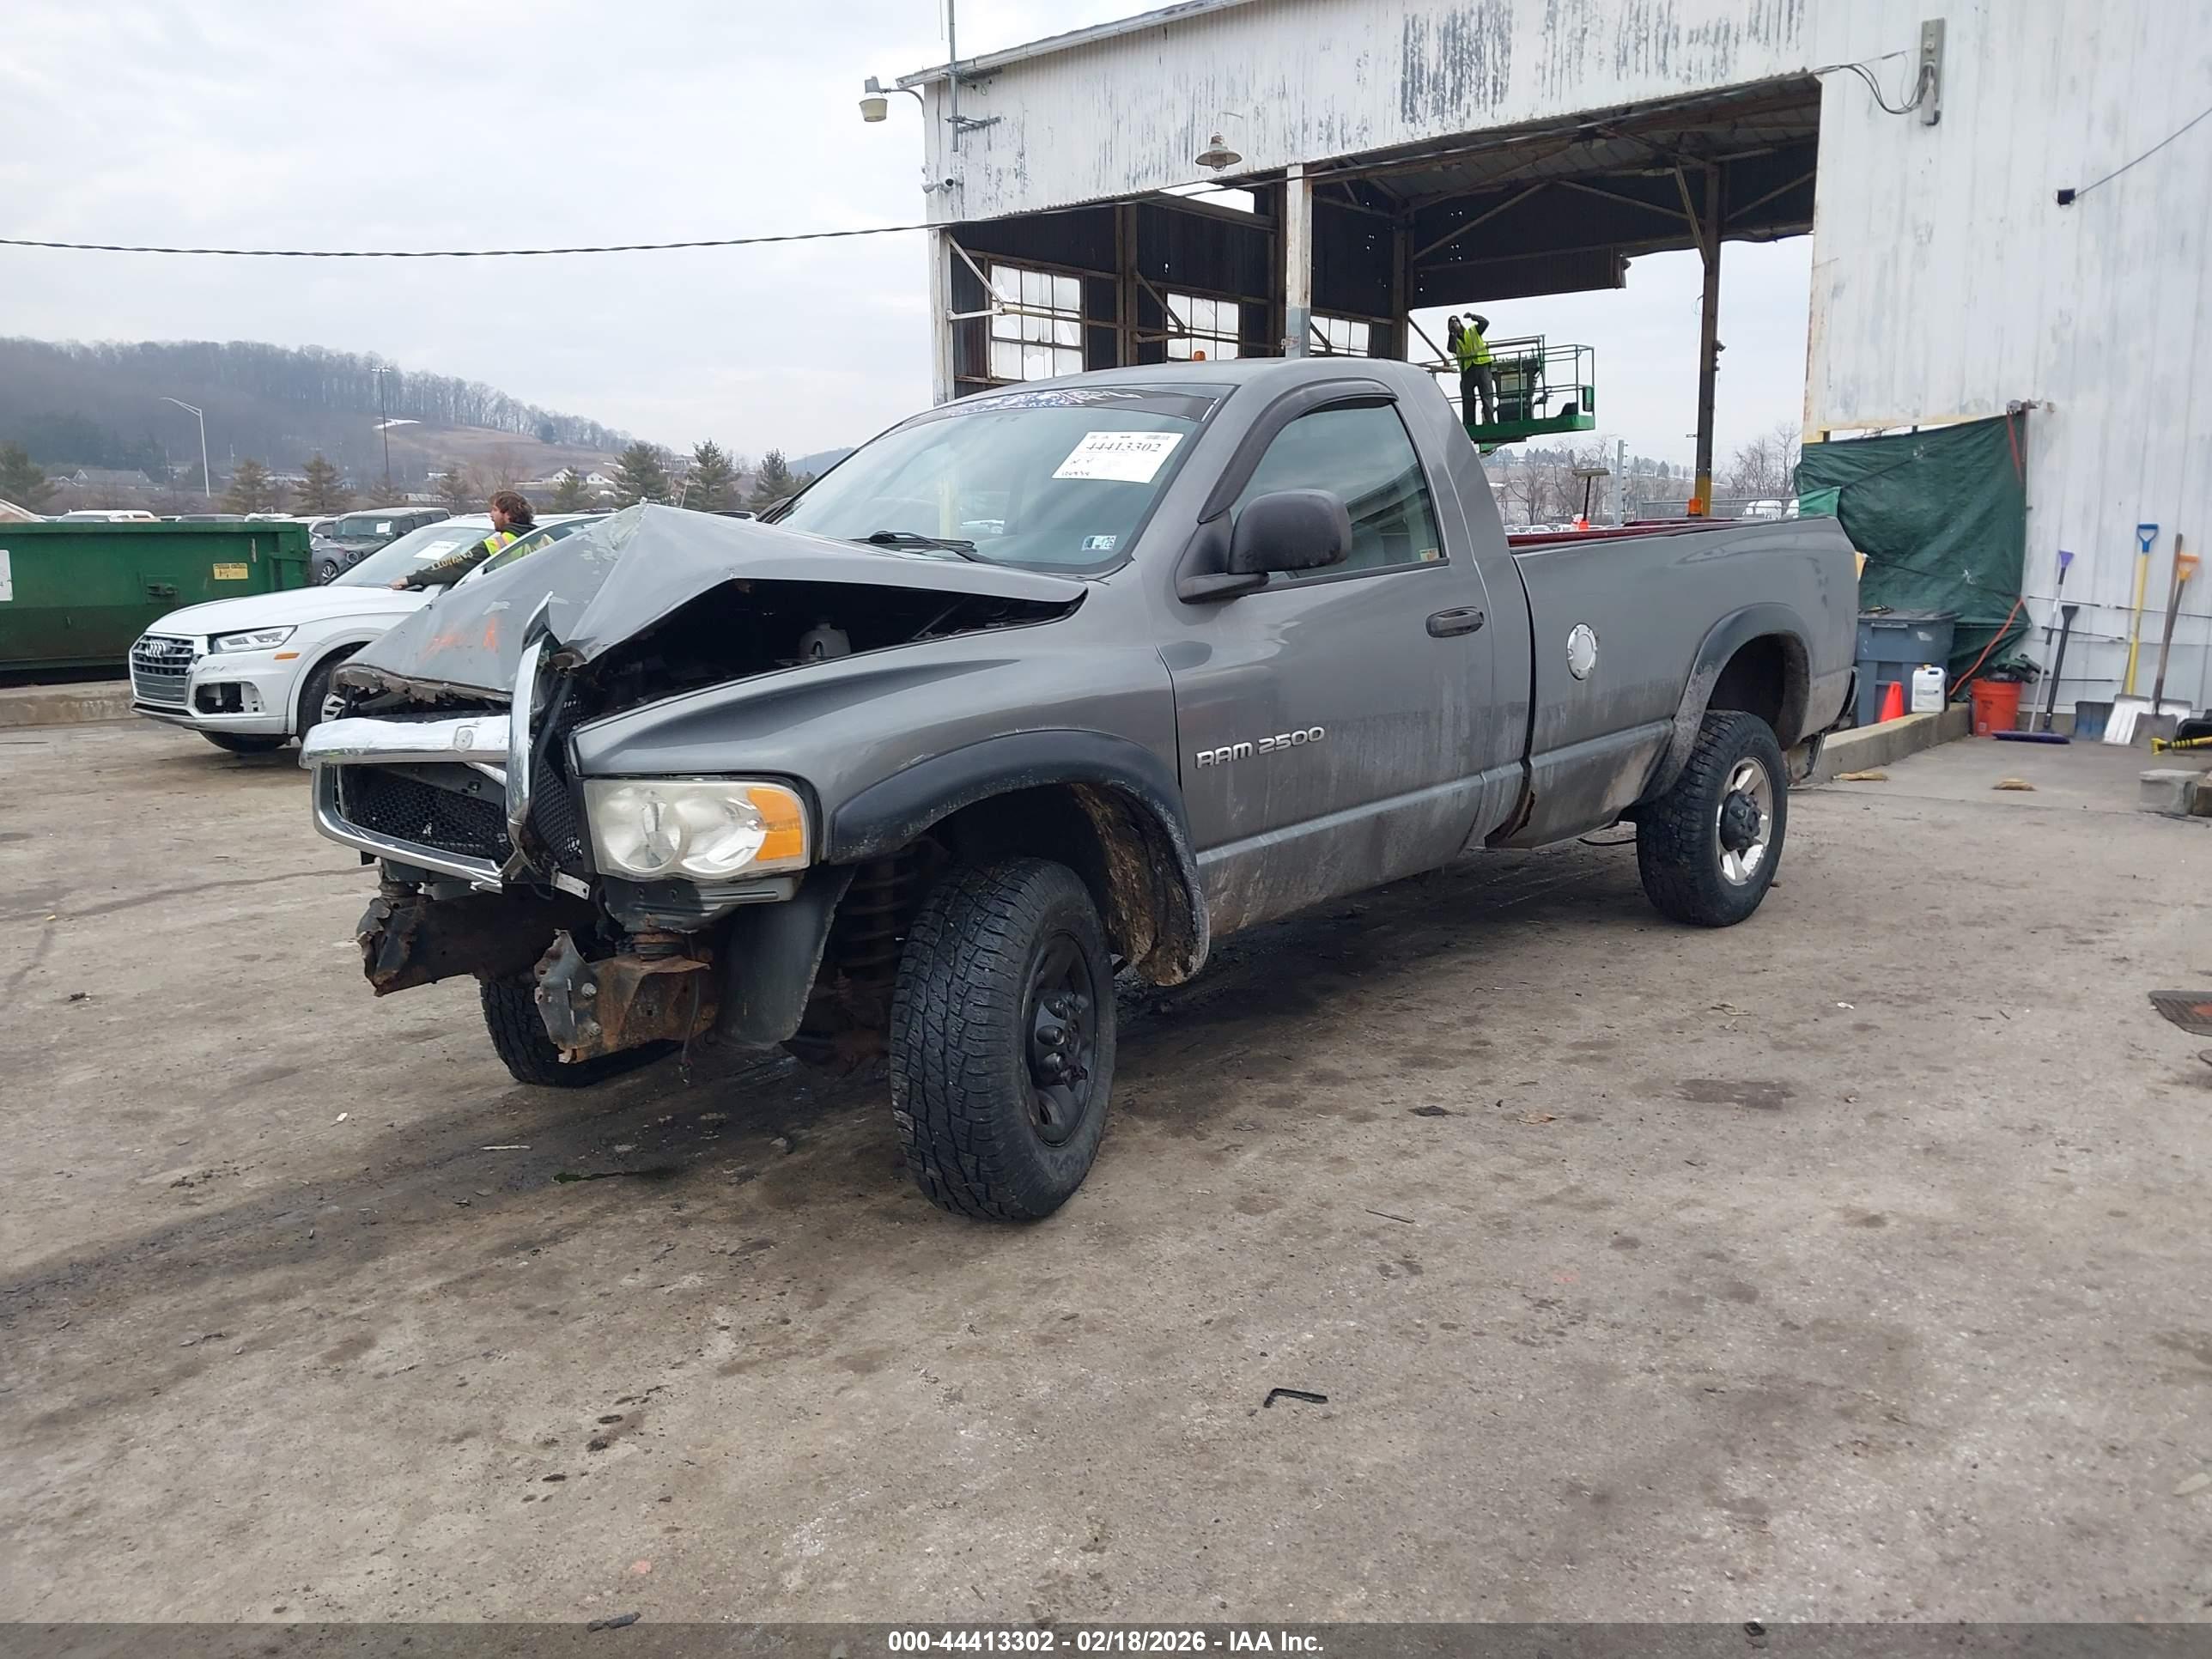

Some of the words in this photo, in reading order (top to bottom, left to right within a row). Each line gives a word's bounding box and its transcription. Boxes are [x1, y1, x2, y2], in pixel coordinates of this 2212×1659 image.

[1085, 441, 1162, 453] 44413302
[1196, 741, 1253, 769] RAM
[1258, 726, 1325, 755] 2500
